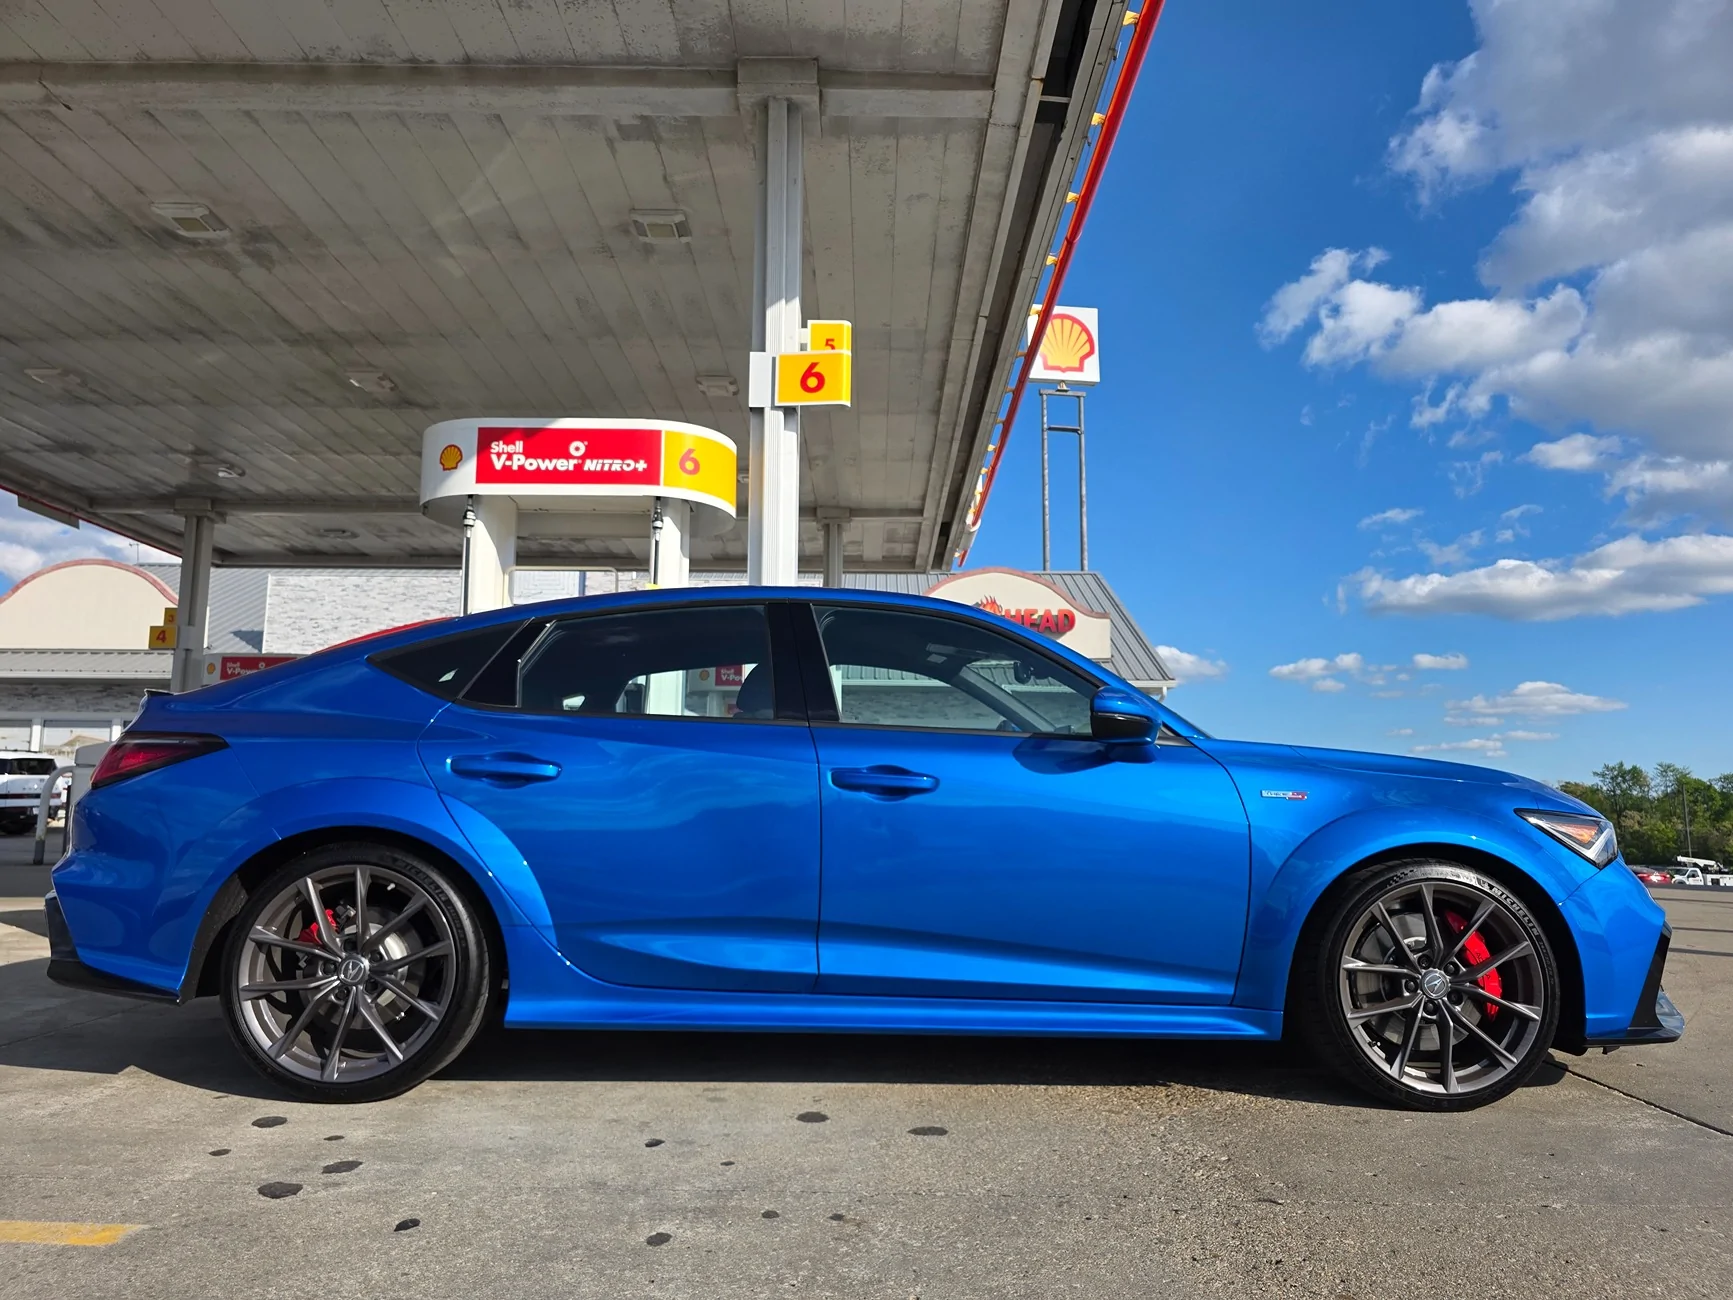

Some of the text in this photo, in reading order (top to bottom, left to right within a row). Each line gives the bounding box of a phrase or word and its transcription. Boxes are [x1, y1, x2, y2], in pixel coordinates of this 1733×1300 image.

[800, 362, 825, 393] 6
[490, 441, 523, 453] Shell
[679, 448, 700, 475] 6
[156, 630, 167, 643] 4
[1492, 886, 1539, 936] MICHELIN
